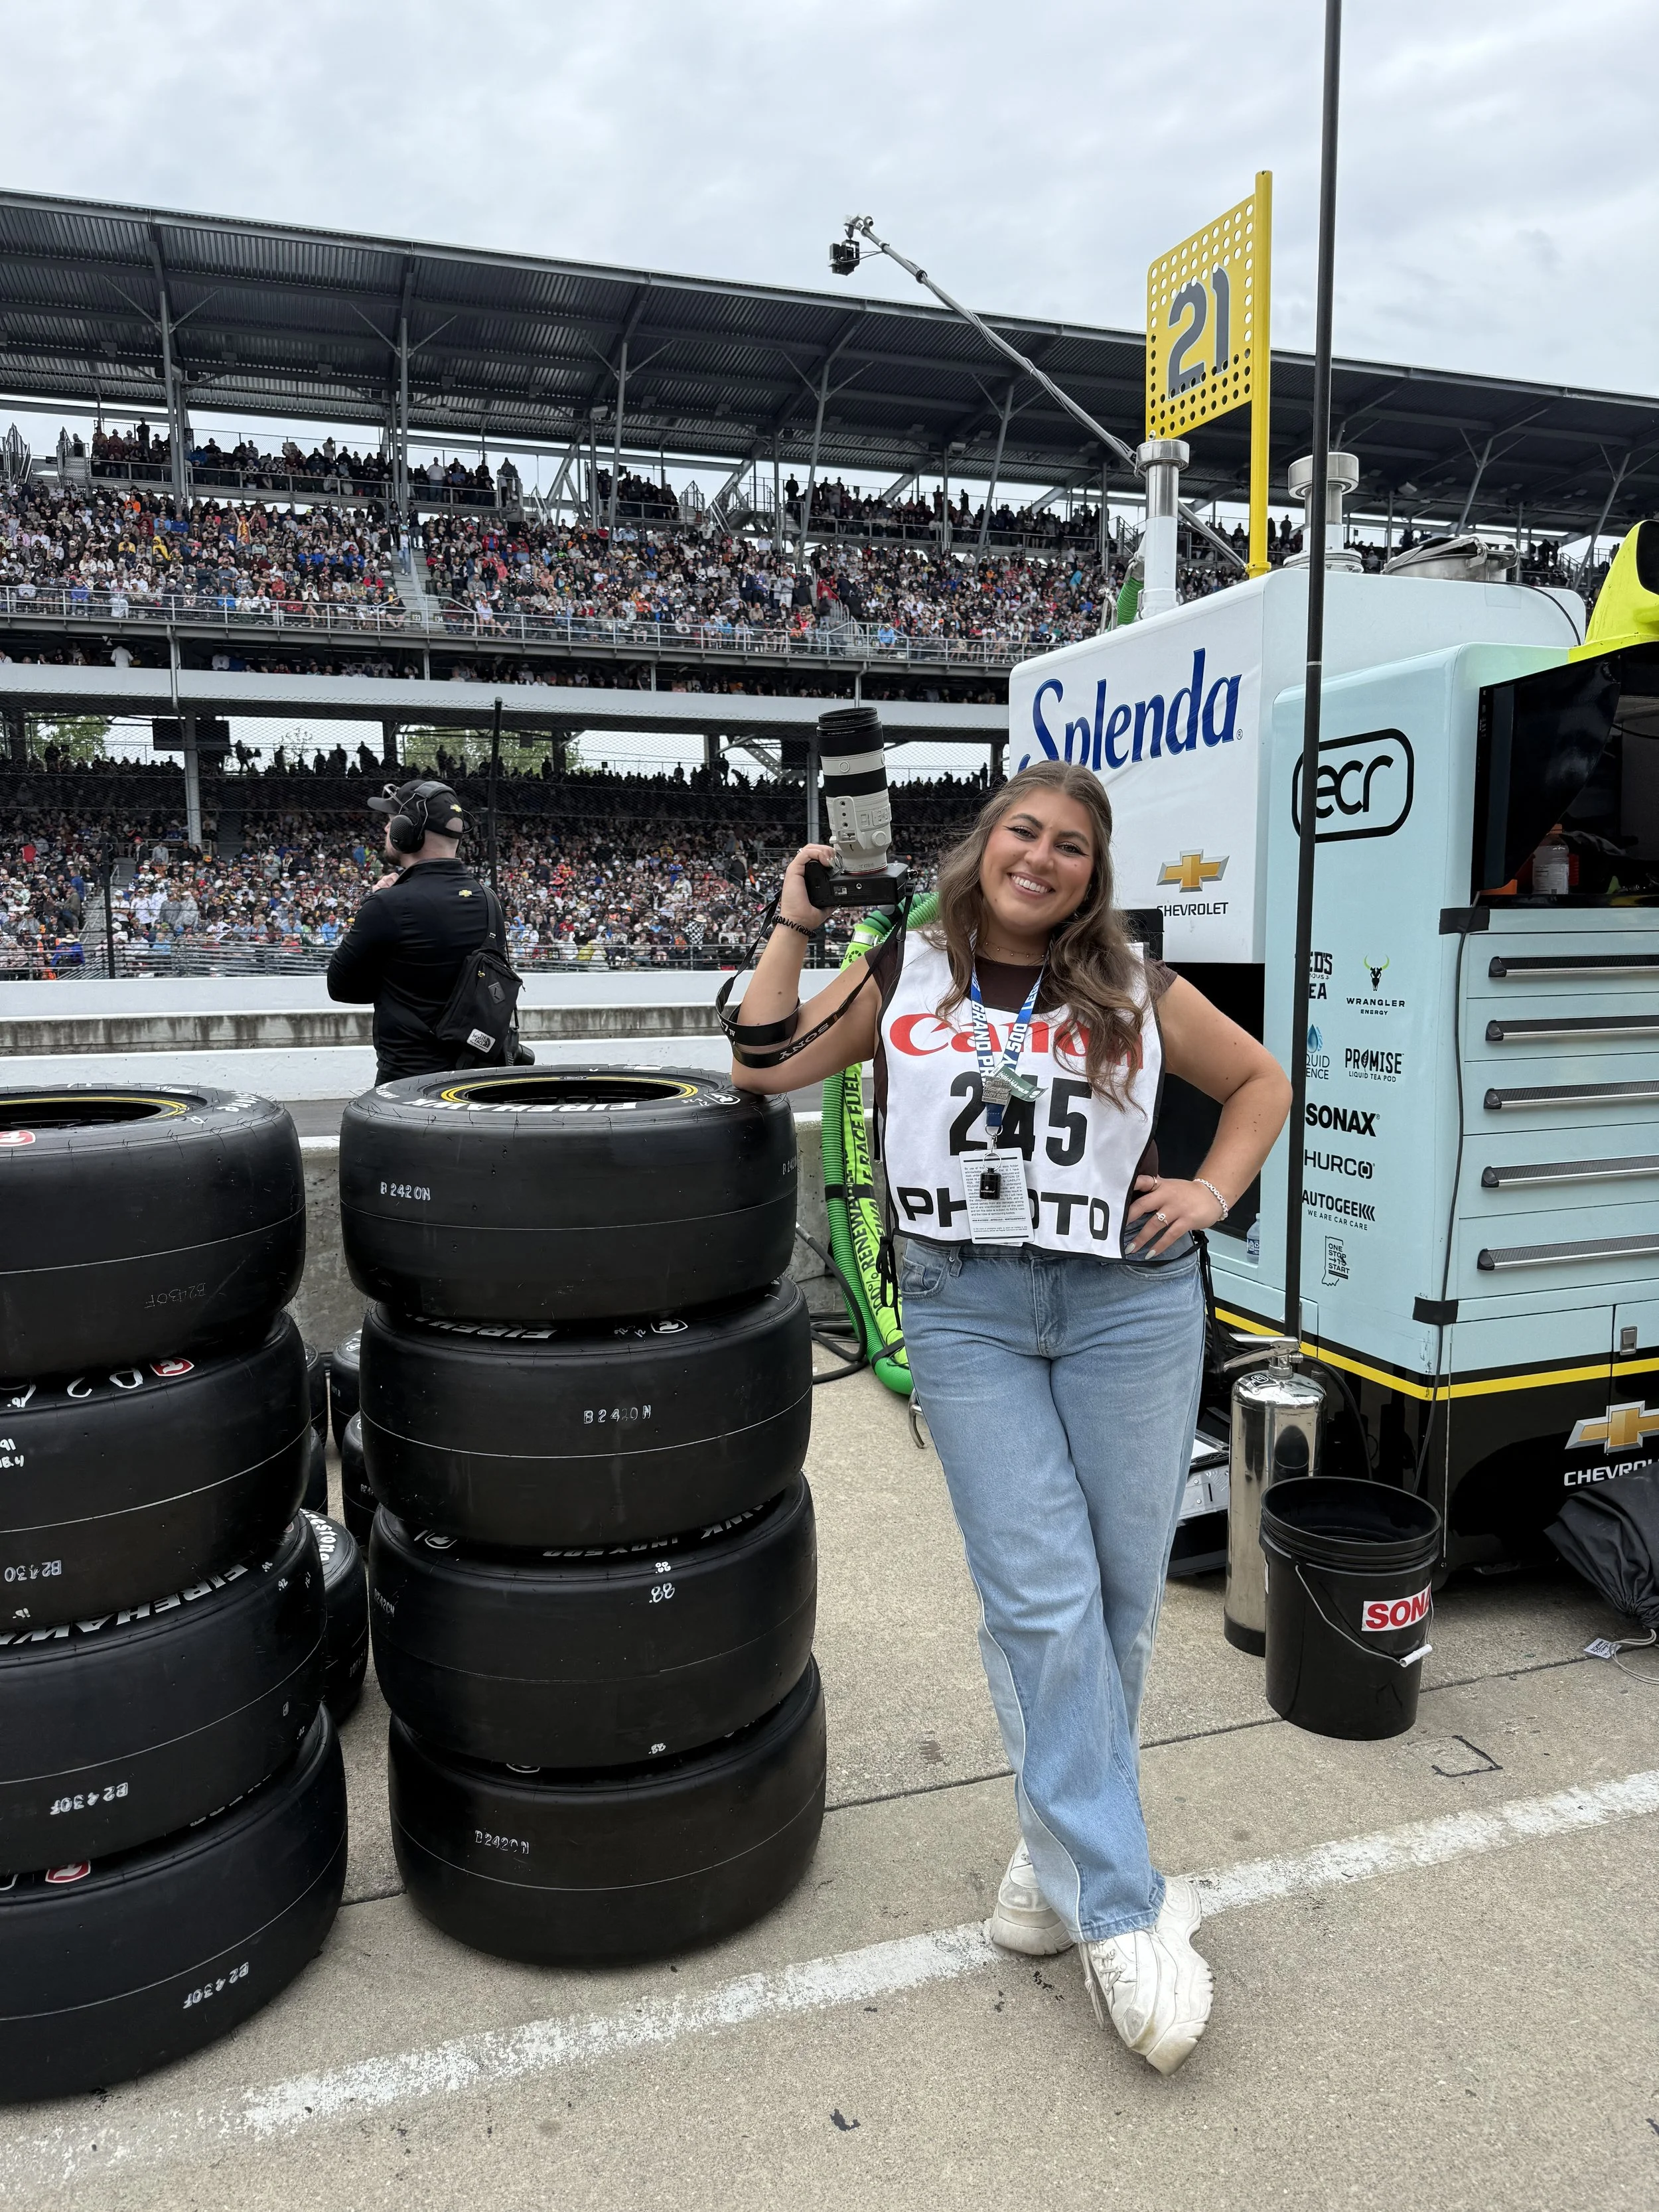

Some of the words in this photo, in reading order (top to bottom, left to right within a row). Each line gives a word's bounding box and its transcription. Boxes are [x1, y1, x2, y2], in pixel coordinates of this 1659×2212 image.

[1167, 266, 1230, 401] 21
[1018, 647, 1242, 774] Splenda
[1316, 755, 1394, 819] ecr
[1346, 997, 1406, 1007] WRANGLER
[972, 999, 991, 1051] GRAND
[1007, 1023, 1028, 1053] 500
[779, 1023, 830, 1061] SONY
[1306, 1054, 1330, 1068] QUID
[1345, 1048, 1402, 1074] PROMISE
[402, 1097, 638, 1113] FIREHAWK
[844, 1072, 861, 1116] FUEL
[950, 1070, 1094, 1167] 245
[1305, 1102, 1376, 1137] SONAX
[853, 1120, 869, 1165] RACE
[1304, 1149, 1373, 1179] HURCO
[1334, 1217, 1348, 1225] CAR
[1349, 1220, 1368, 1230] CARE
[1328, 1243, 1343, 1252] ONE
[1328, 1250, 1346, 1259] STOP
[1328, 1262, 1350, 1274] START
[865, 1272, 883, 1317] 100%
[1563, 1459, 1659, 1487] CHEVRO
